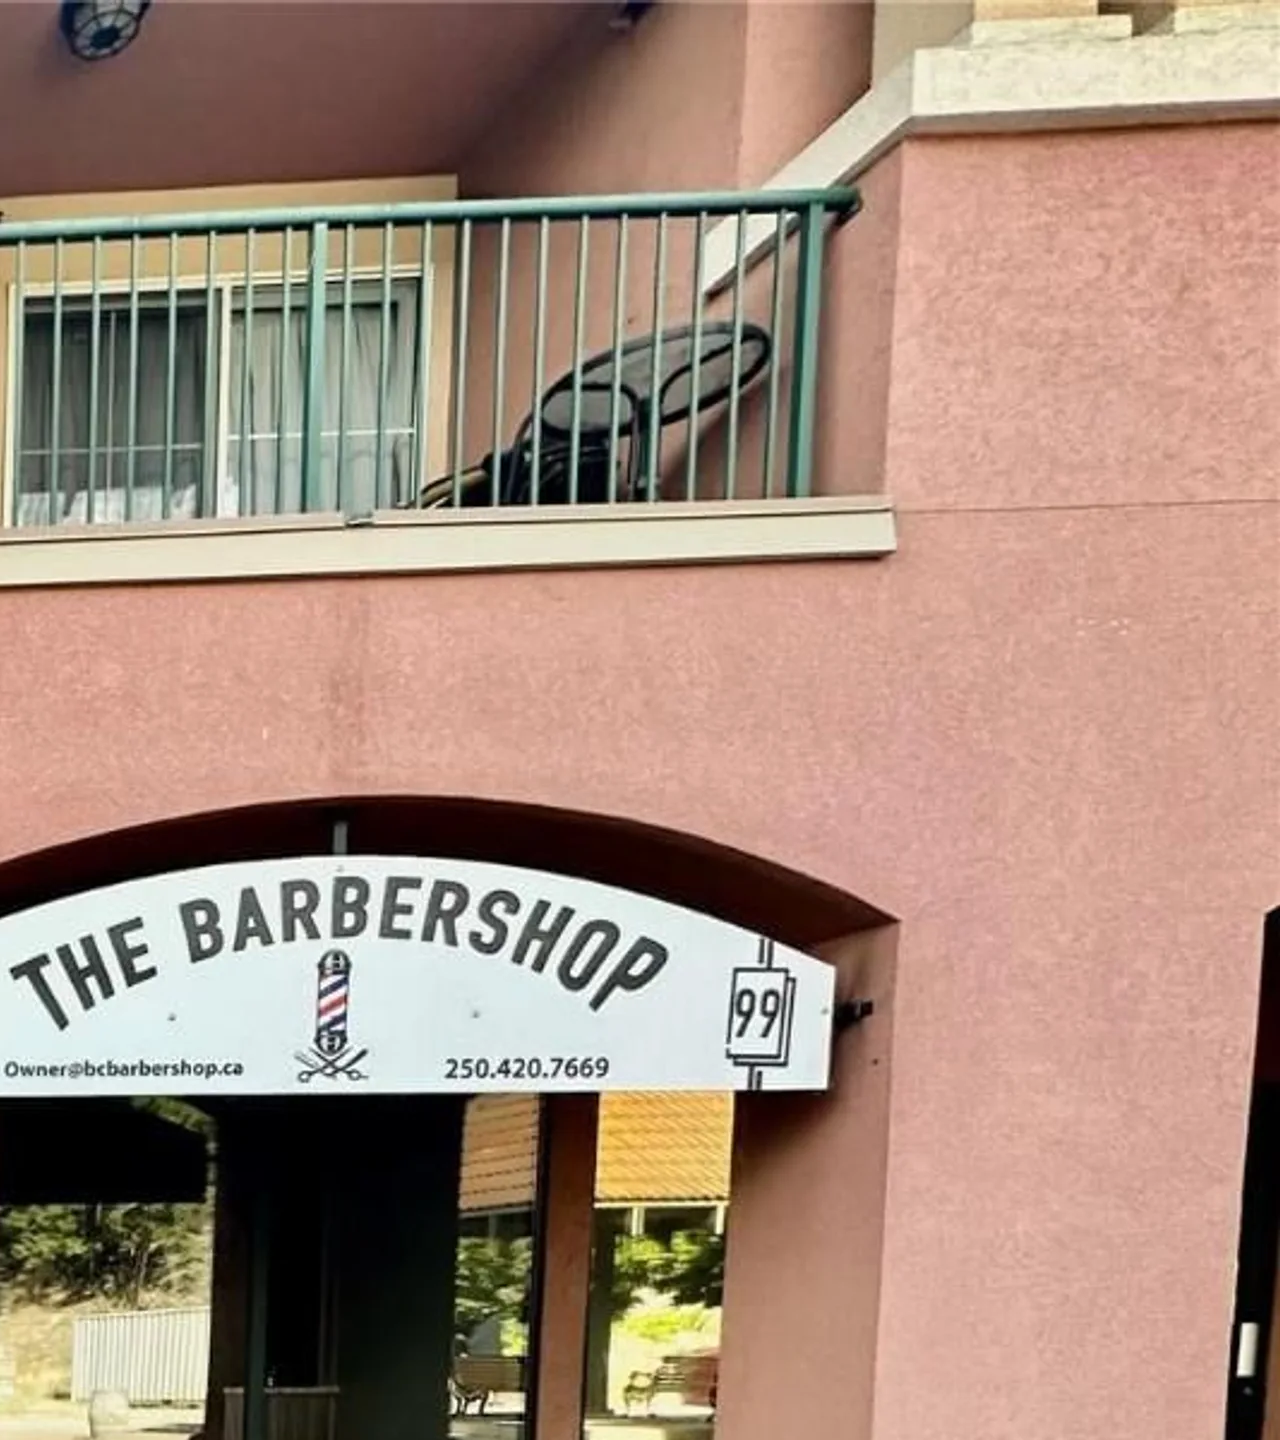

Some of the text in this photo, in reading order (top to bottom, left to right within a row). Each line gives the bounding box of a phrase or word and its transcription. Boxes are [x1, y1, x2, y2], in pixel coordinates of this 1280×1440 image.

[10, 875, 671, 1031] THE BARBERSHOP
[734, 988, 781, 1039] 99
[3, 1060, 244, 1080] Owner@bcbarbershop.ca
[444, 1057, 610, 1079] 250.420.7669
